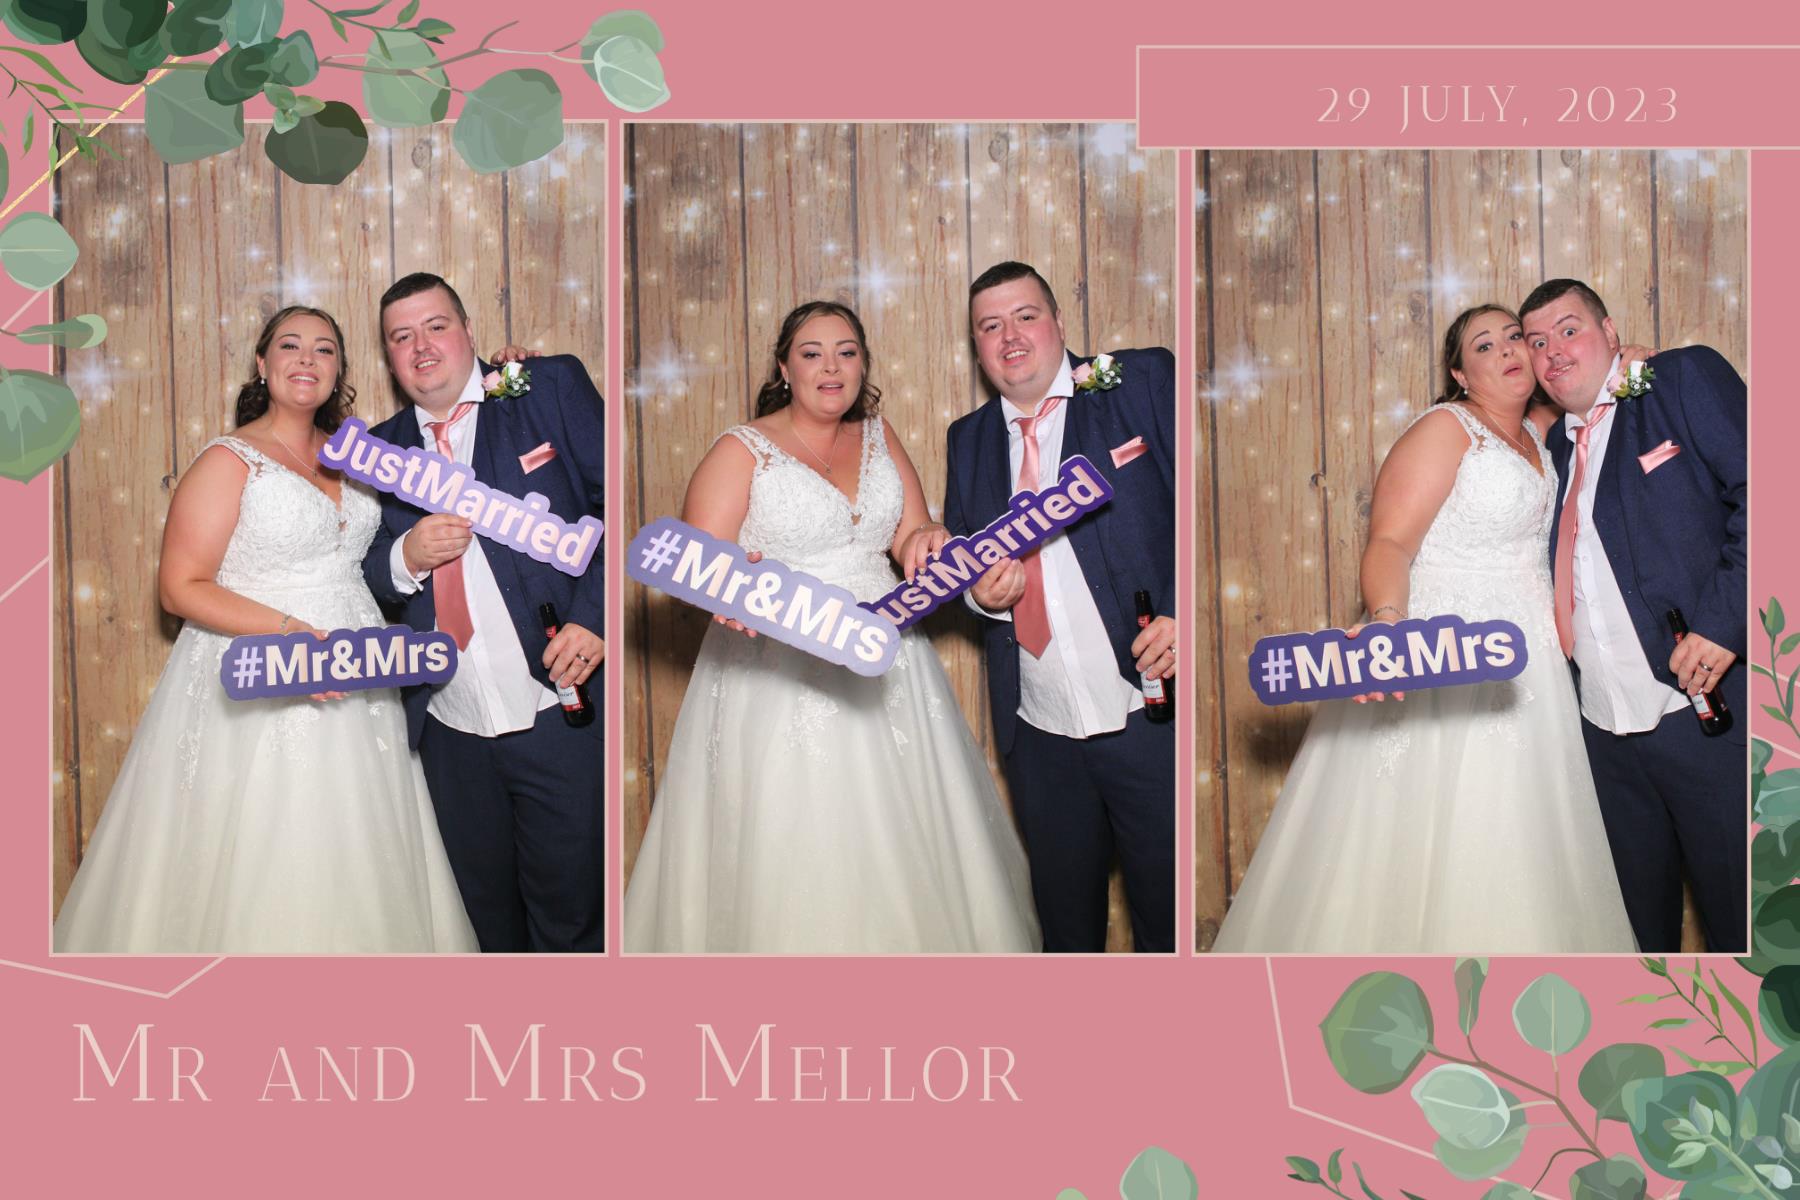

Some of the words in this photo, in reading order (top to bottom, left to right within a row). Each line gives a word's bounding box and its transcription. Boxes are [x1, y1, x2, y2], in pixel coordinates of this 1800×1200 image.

[323, 424, 596, 567] JustMarried
[875, 464, 1105, 626] ustMarried
[232, 635, 449, 689] #Mr&Mrs
[640, 529, 889, 664] #Mr&Mrs
[1261, 626, 1516, 693] #Mr&Mrs
